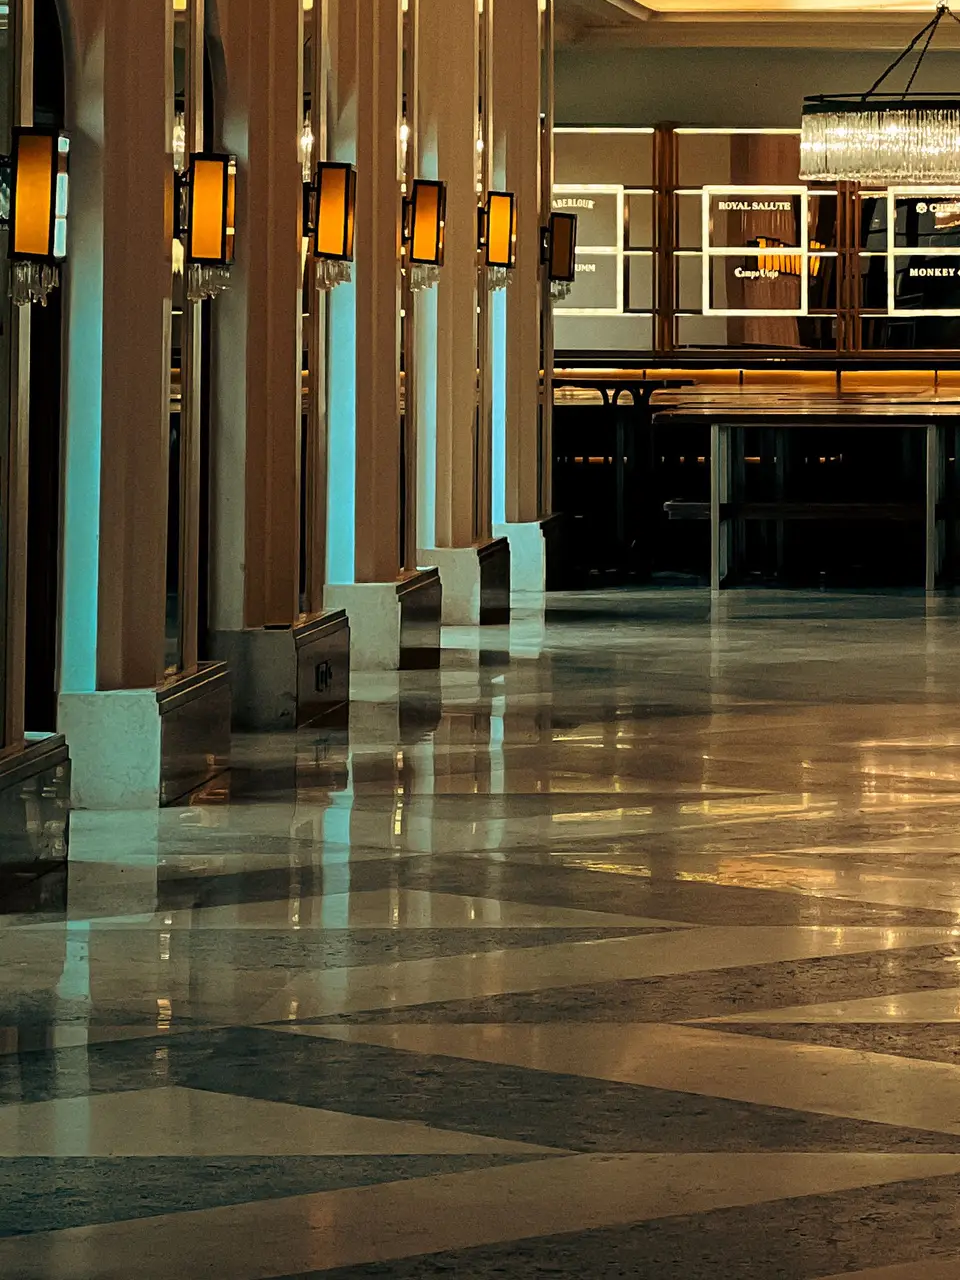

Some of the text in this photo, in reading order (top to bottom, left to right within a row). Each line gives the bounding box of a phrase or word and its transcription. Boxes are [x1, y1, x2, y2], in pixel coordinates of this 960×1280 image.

[552, 198, 595, 209] ABERLOUR
[718, 201, 791, 210] ROYAL SALUTE
[575, 264, 596, 272] UMM
[909, 268, 955, 277] MONKEY
[734, 267, 760, 279] Campo
